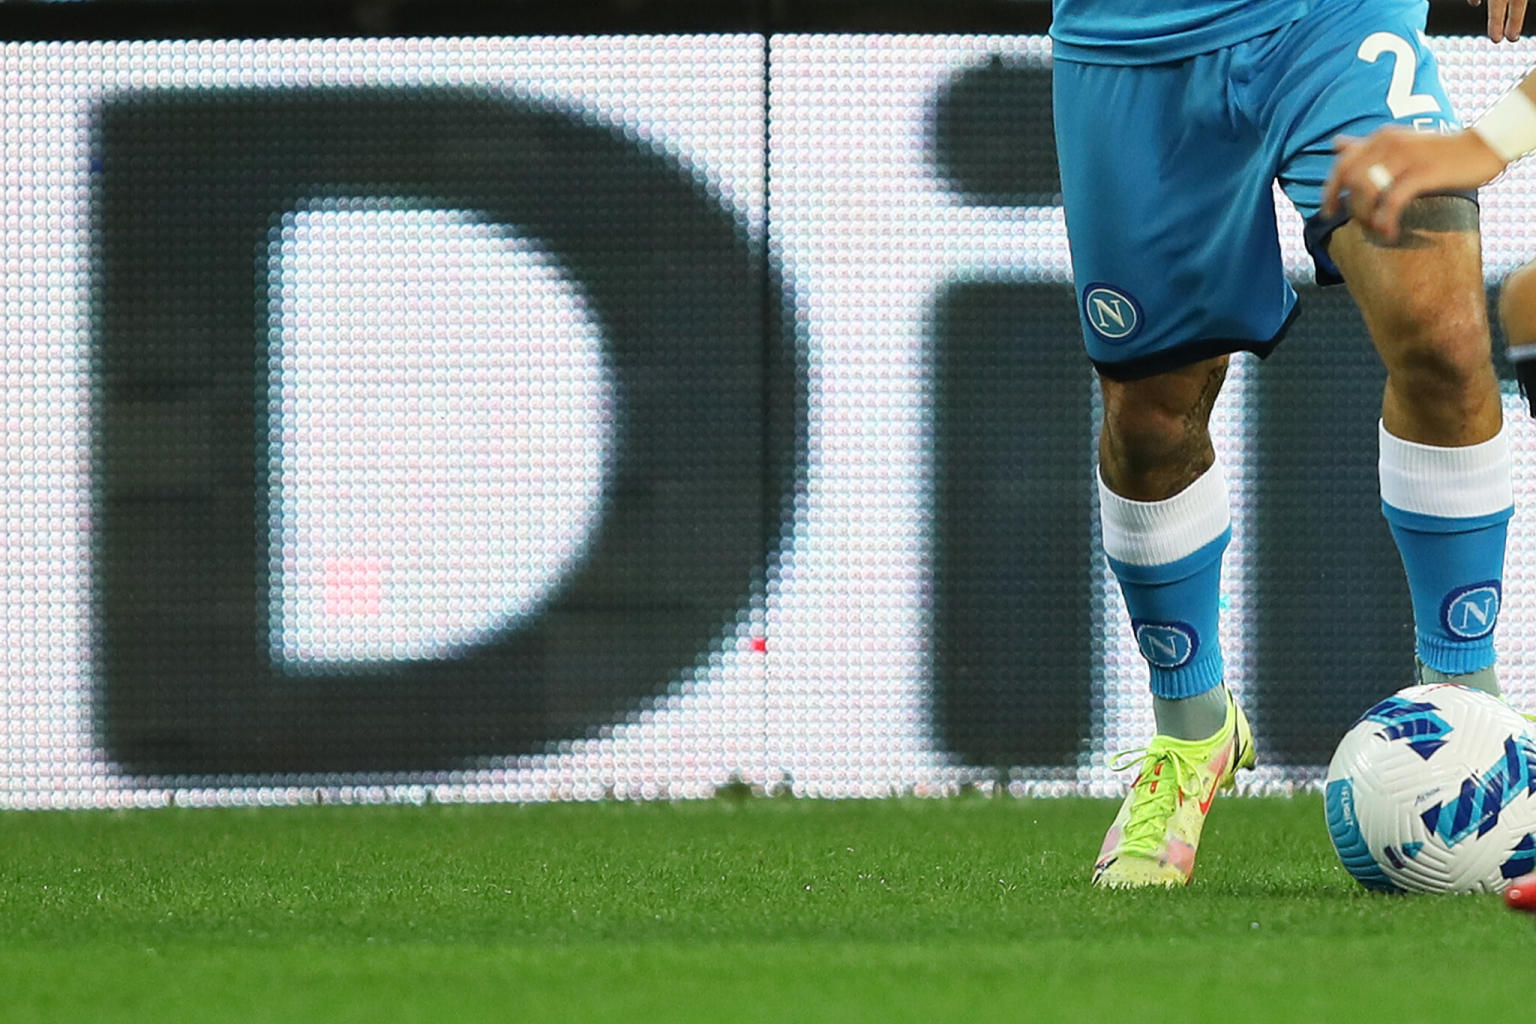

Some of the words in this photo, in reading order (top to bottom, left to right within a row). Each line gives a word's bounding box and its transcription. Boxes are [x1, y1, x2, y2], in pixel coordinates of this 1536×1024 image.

[1357, 29, 1441, 119] 2
[1092, 298, 1126, 328] N
[1459, 596, 1493, 630] N
[1142, 633, 1178, 660] N
